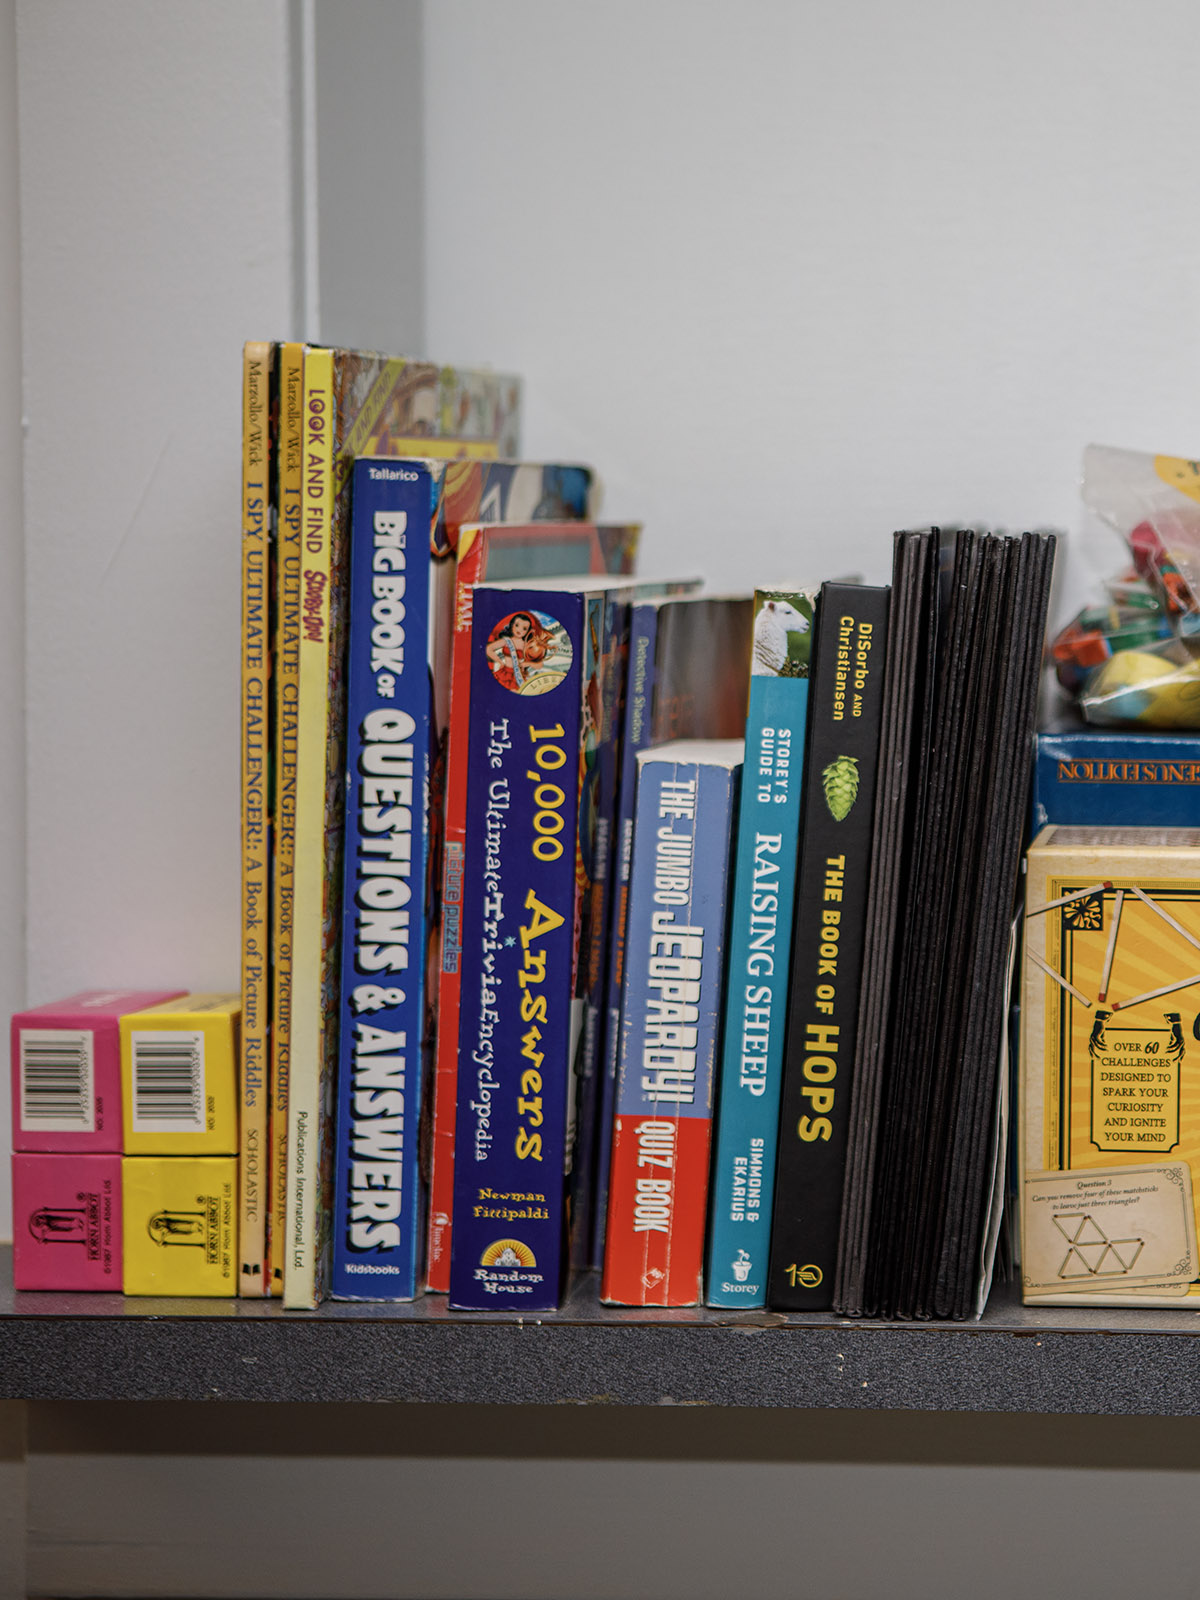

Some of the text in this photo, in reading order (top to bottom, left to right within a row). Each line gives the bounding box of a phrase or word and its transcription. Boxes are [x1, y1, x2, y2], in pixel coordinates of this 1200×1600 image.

[246, 360, 264, 466] Marzollo/Wick
[306, 389, 325, 553] LOOK AND FIND
[369, 466, 419, 482] Tallarico
[245, 499, 264, 541] SPY
[283, 504, 300, 545] SPY
[245, 550, 263, 668] ULTIMATE
[283, 556, 300, 674] ULTIMATE
[630, 636, 652, 744] Detective Shadow
[833, 616, 855, 721] Christiansen
[852, 623, 873, 717] DiSorbo AND
[757, 727, 775, 803] GUIDE TO
[774, 729, 792, 804] STOREY'S
[1059, 763, 1140, 781] EDITION
[246, 858, 261, 872] A
[345, 511, 416, 1253] BIG BOOK OF QUESTIONS & ANSWERS
[244, 881, 263, 930] Book
[279, 886, 293, 932] Book
[443, 842, 465, 973] picture puzzles
[244, 939, 262, 960] of
[468, 719, 512, 1162] The Ultimate Trivia Encyclopedia
[514, 722, 567, 1161] 10,000 Answers
[642, 780, 704, 1104] THE JUMBO JEOPARDY!
[740, 832, 783, 1097] RAISING SHEEP
[244, 966, 262, 1028] Picture
[798, 855, 846, 1143] THE BOOK OF HOPS
[244, 1039, 262, 1107] Riddles
[1101, 1057, 1171, 1067] CHALLENGES
[1113, 1042, 1160, 1054] OVER 60
[1100, 1072, 1172, 1083] DESIGNED TO
[1103, 1087, 1169, 1098] SPARK YOUR
[1104, 1117, 1167, 1127] AND IGNITE
[1107, 1103, 1163, 1112] CURIOSITY
[294, 1111, 309, 1174] Publications
[1105, 1132, 1166, 1143] YOUR MIND
[246, 1128, 258, 1222] SCHOLASTIC
[479, 1188, 546, 1203] Newman
[634, 1121, 676, 1233] QUIZ BOOK
[730, 1157, 748, 1222] EKARIUS
[747, 1138, 764, 1208] SIMMONS
[1077, 1180, 1107, 1190] Question
[87, 1193, 99, 1260] HORN ABBOT
[103, 1197, 111, 1222] Abbot
[103, 1226, 111, 1246] Horn
[206, 1197, 218, 1264] HORN ABBOT
[223, 1200, 231, 1226] Abbot
[294, 1178, 308, 1248] International,
[473, 1205, 549, 1221] Fittipaldi
[223, 1229, 231, 1250] Horn
[344, 1263, 400, 1276] Kidsbooks
[473, 1269, 544, 1284] Random
[483, 1281, 534, 1295] House
[721, 1283, 760, 1295] Storey
